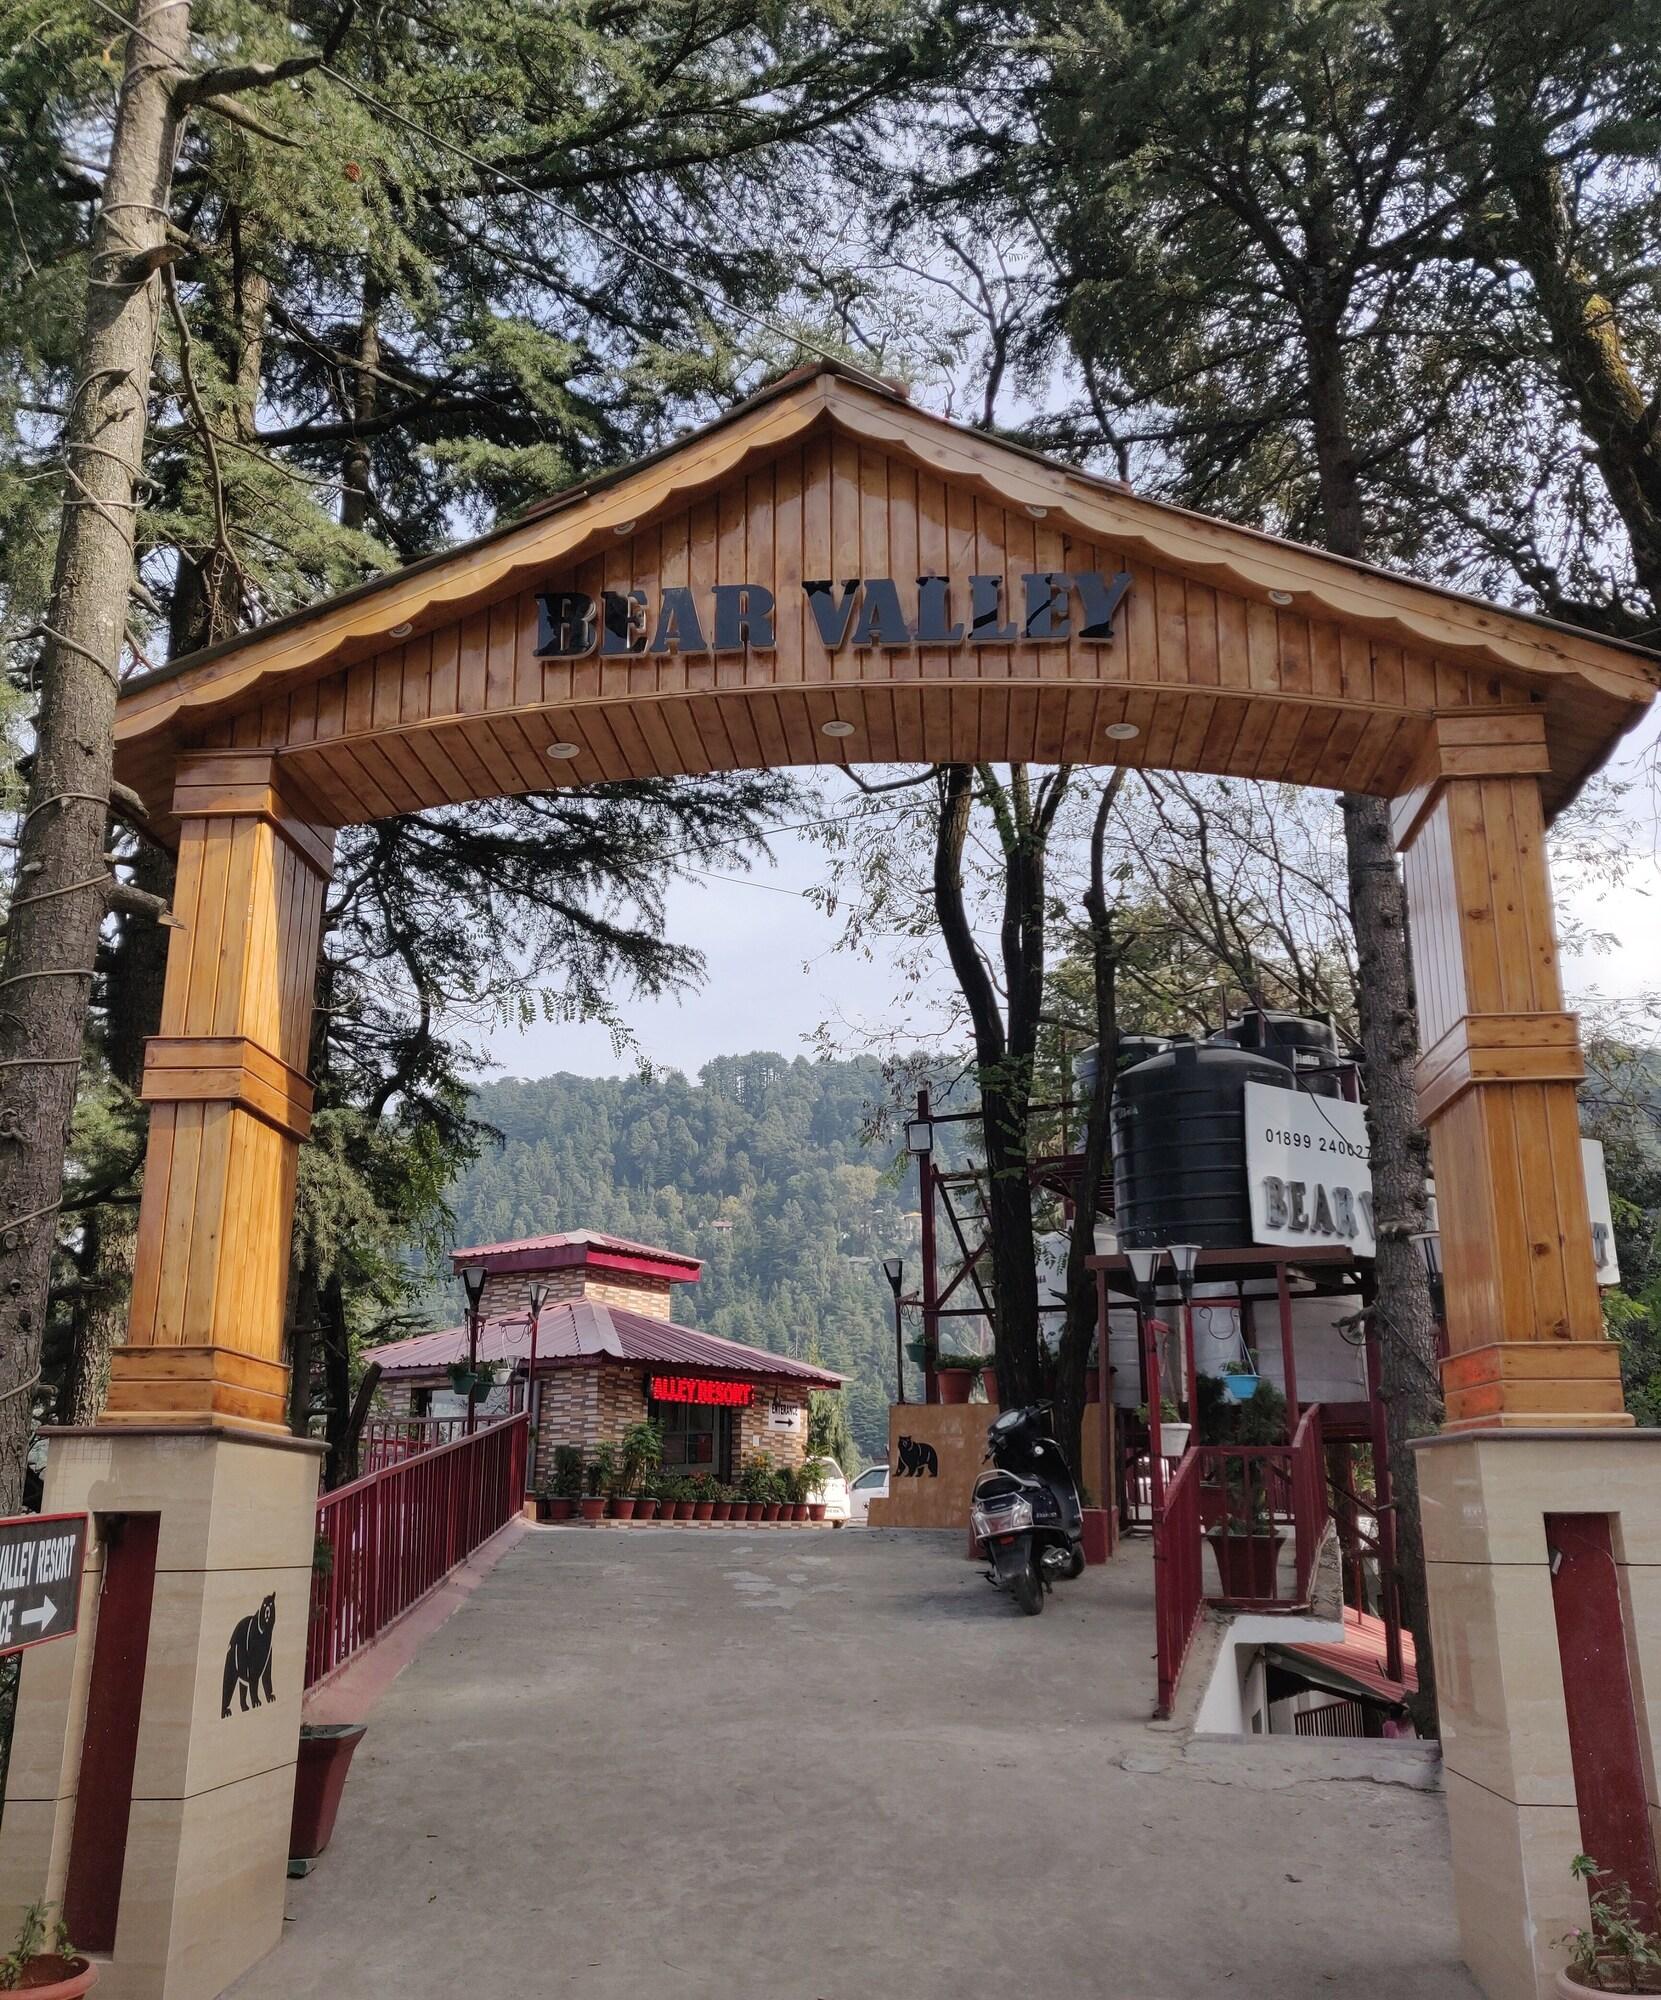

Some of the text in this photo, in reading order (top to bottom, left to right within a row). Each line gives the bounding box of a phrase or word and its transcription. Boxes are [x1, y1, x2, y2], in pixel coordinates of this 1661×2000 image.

[532, 571, 1134, 662] BEAR VALLEY
[1265, 1128, 1312, 1149] 01899
[1262, 1175, 1360, 1239] BEAR
[36, 1534, 77, 1585] RESORT
